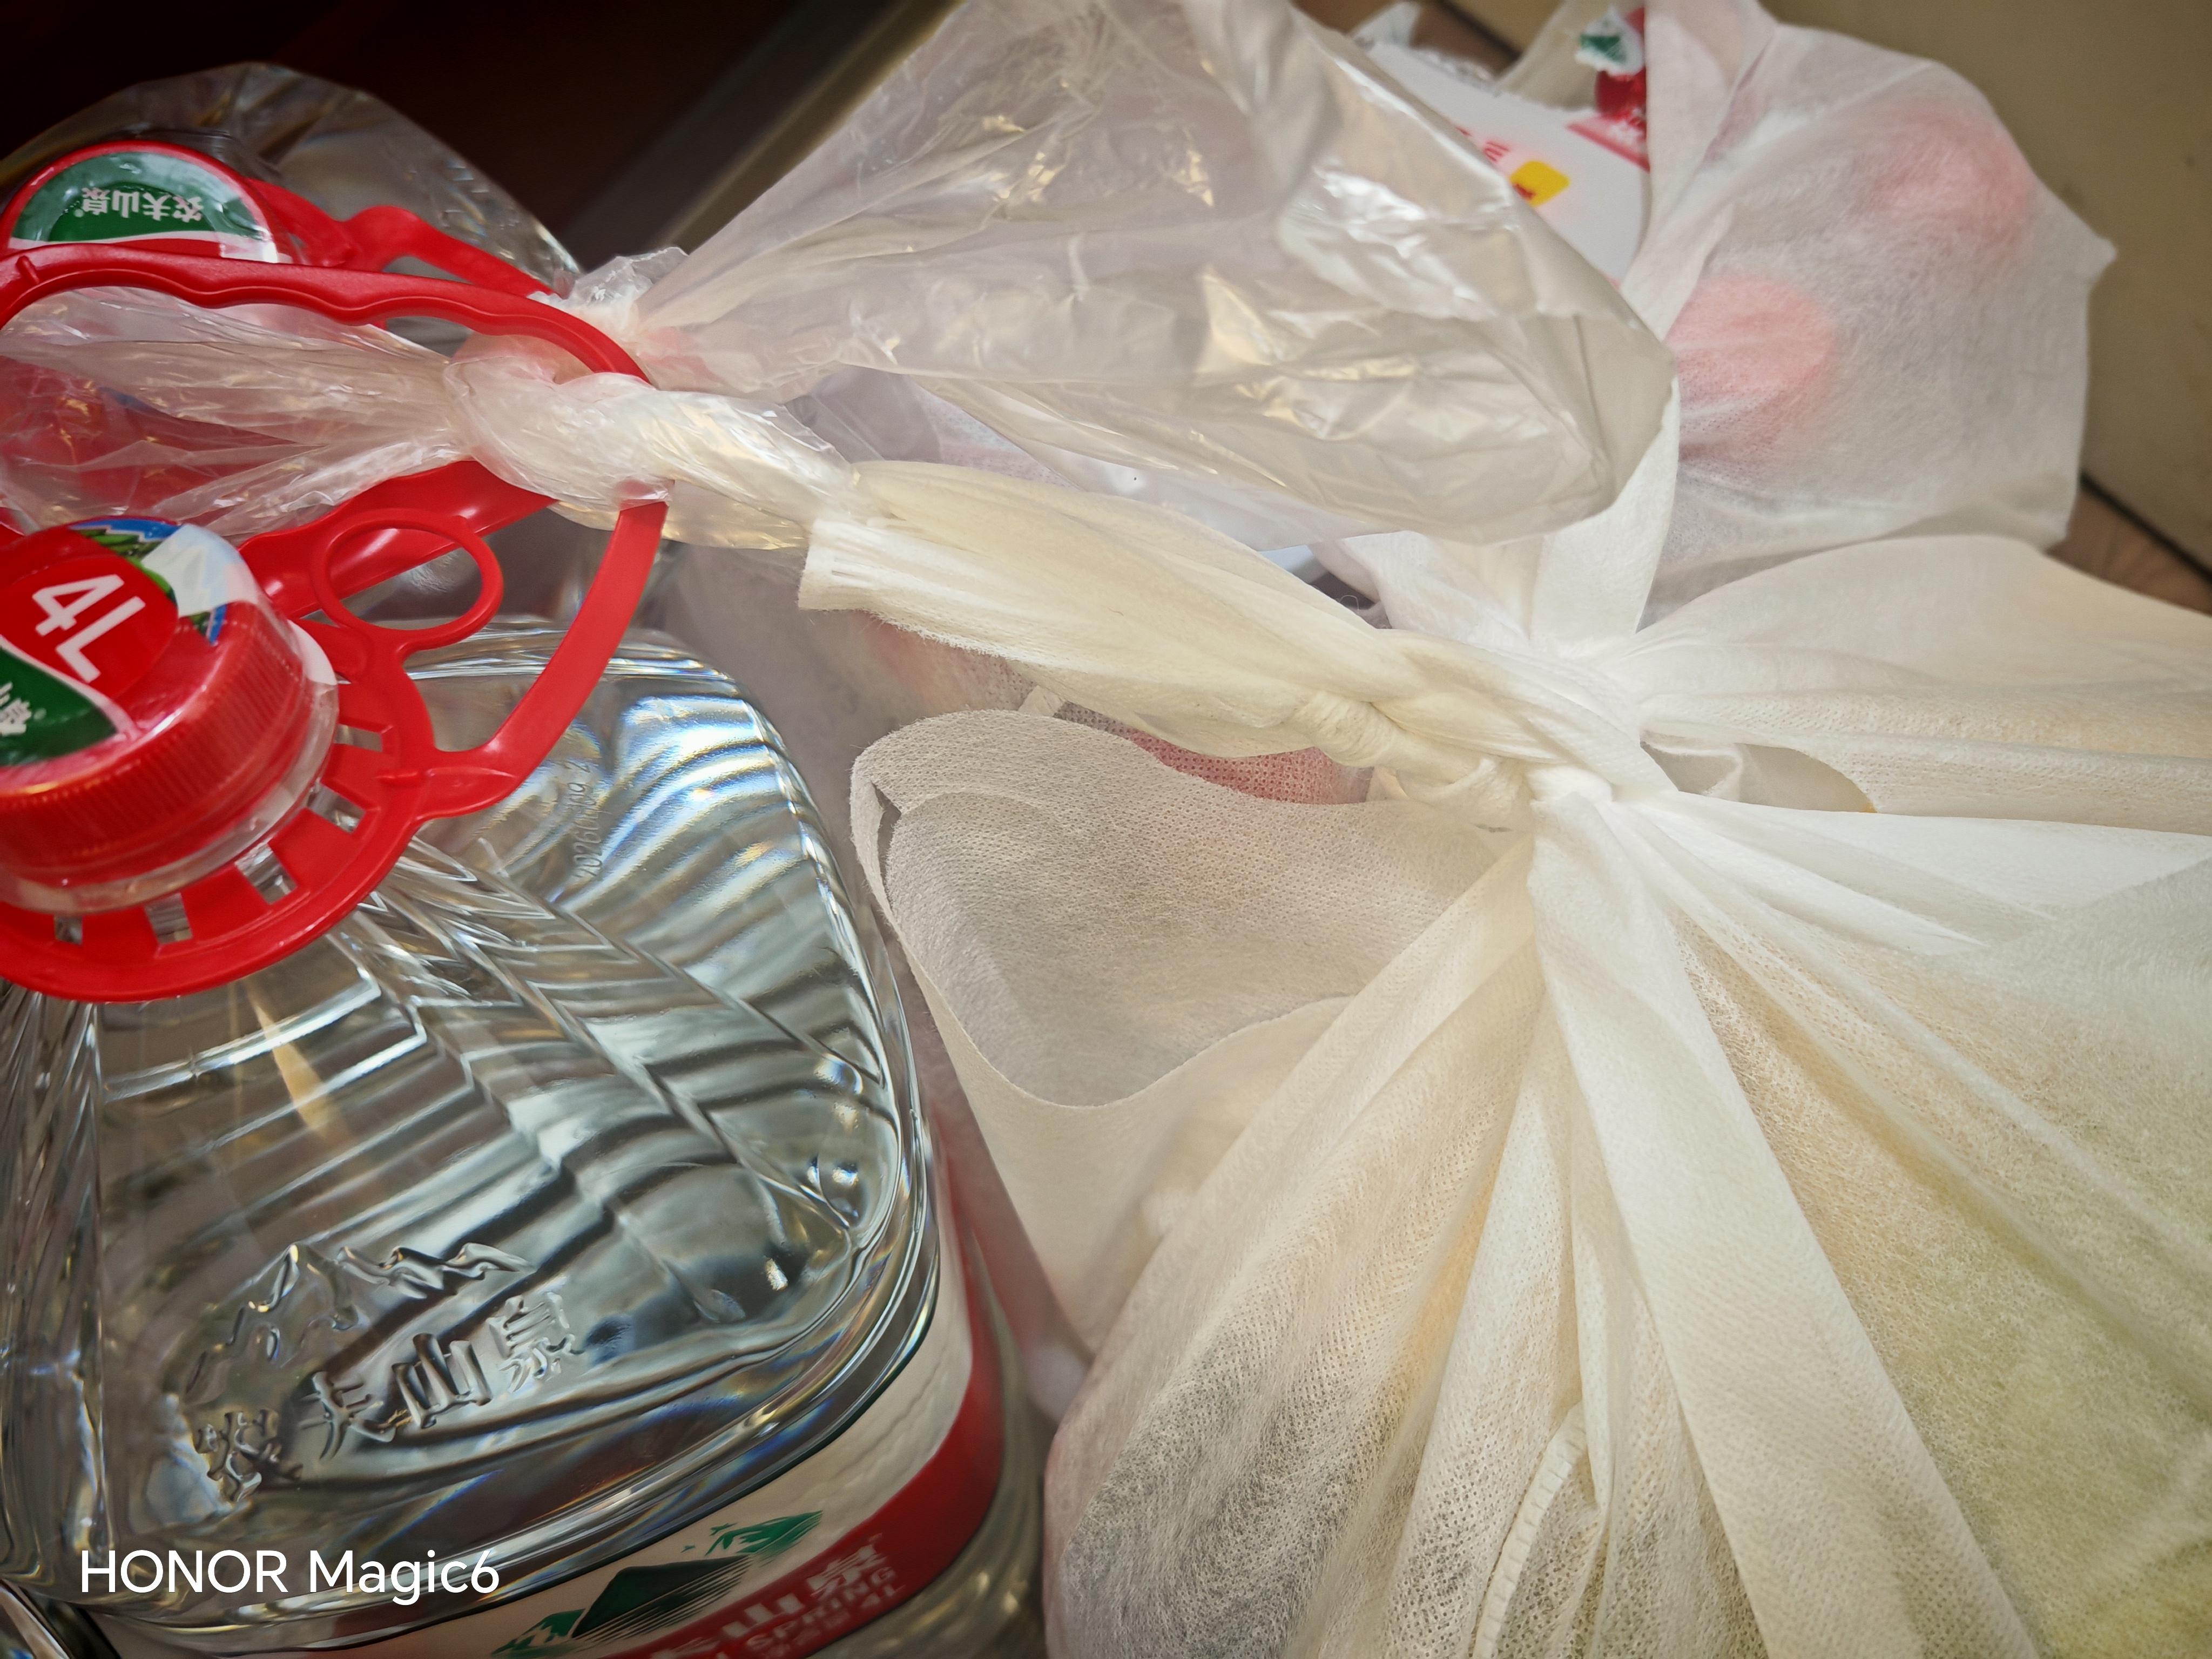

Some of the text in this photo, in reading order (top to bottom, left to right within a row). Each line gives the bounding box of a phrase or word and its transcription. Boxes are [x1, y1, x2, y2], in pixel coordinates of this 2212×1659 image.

[81, 187, 203, 222] 农夫山泉
[32, 574, 146, 683] 4L
